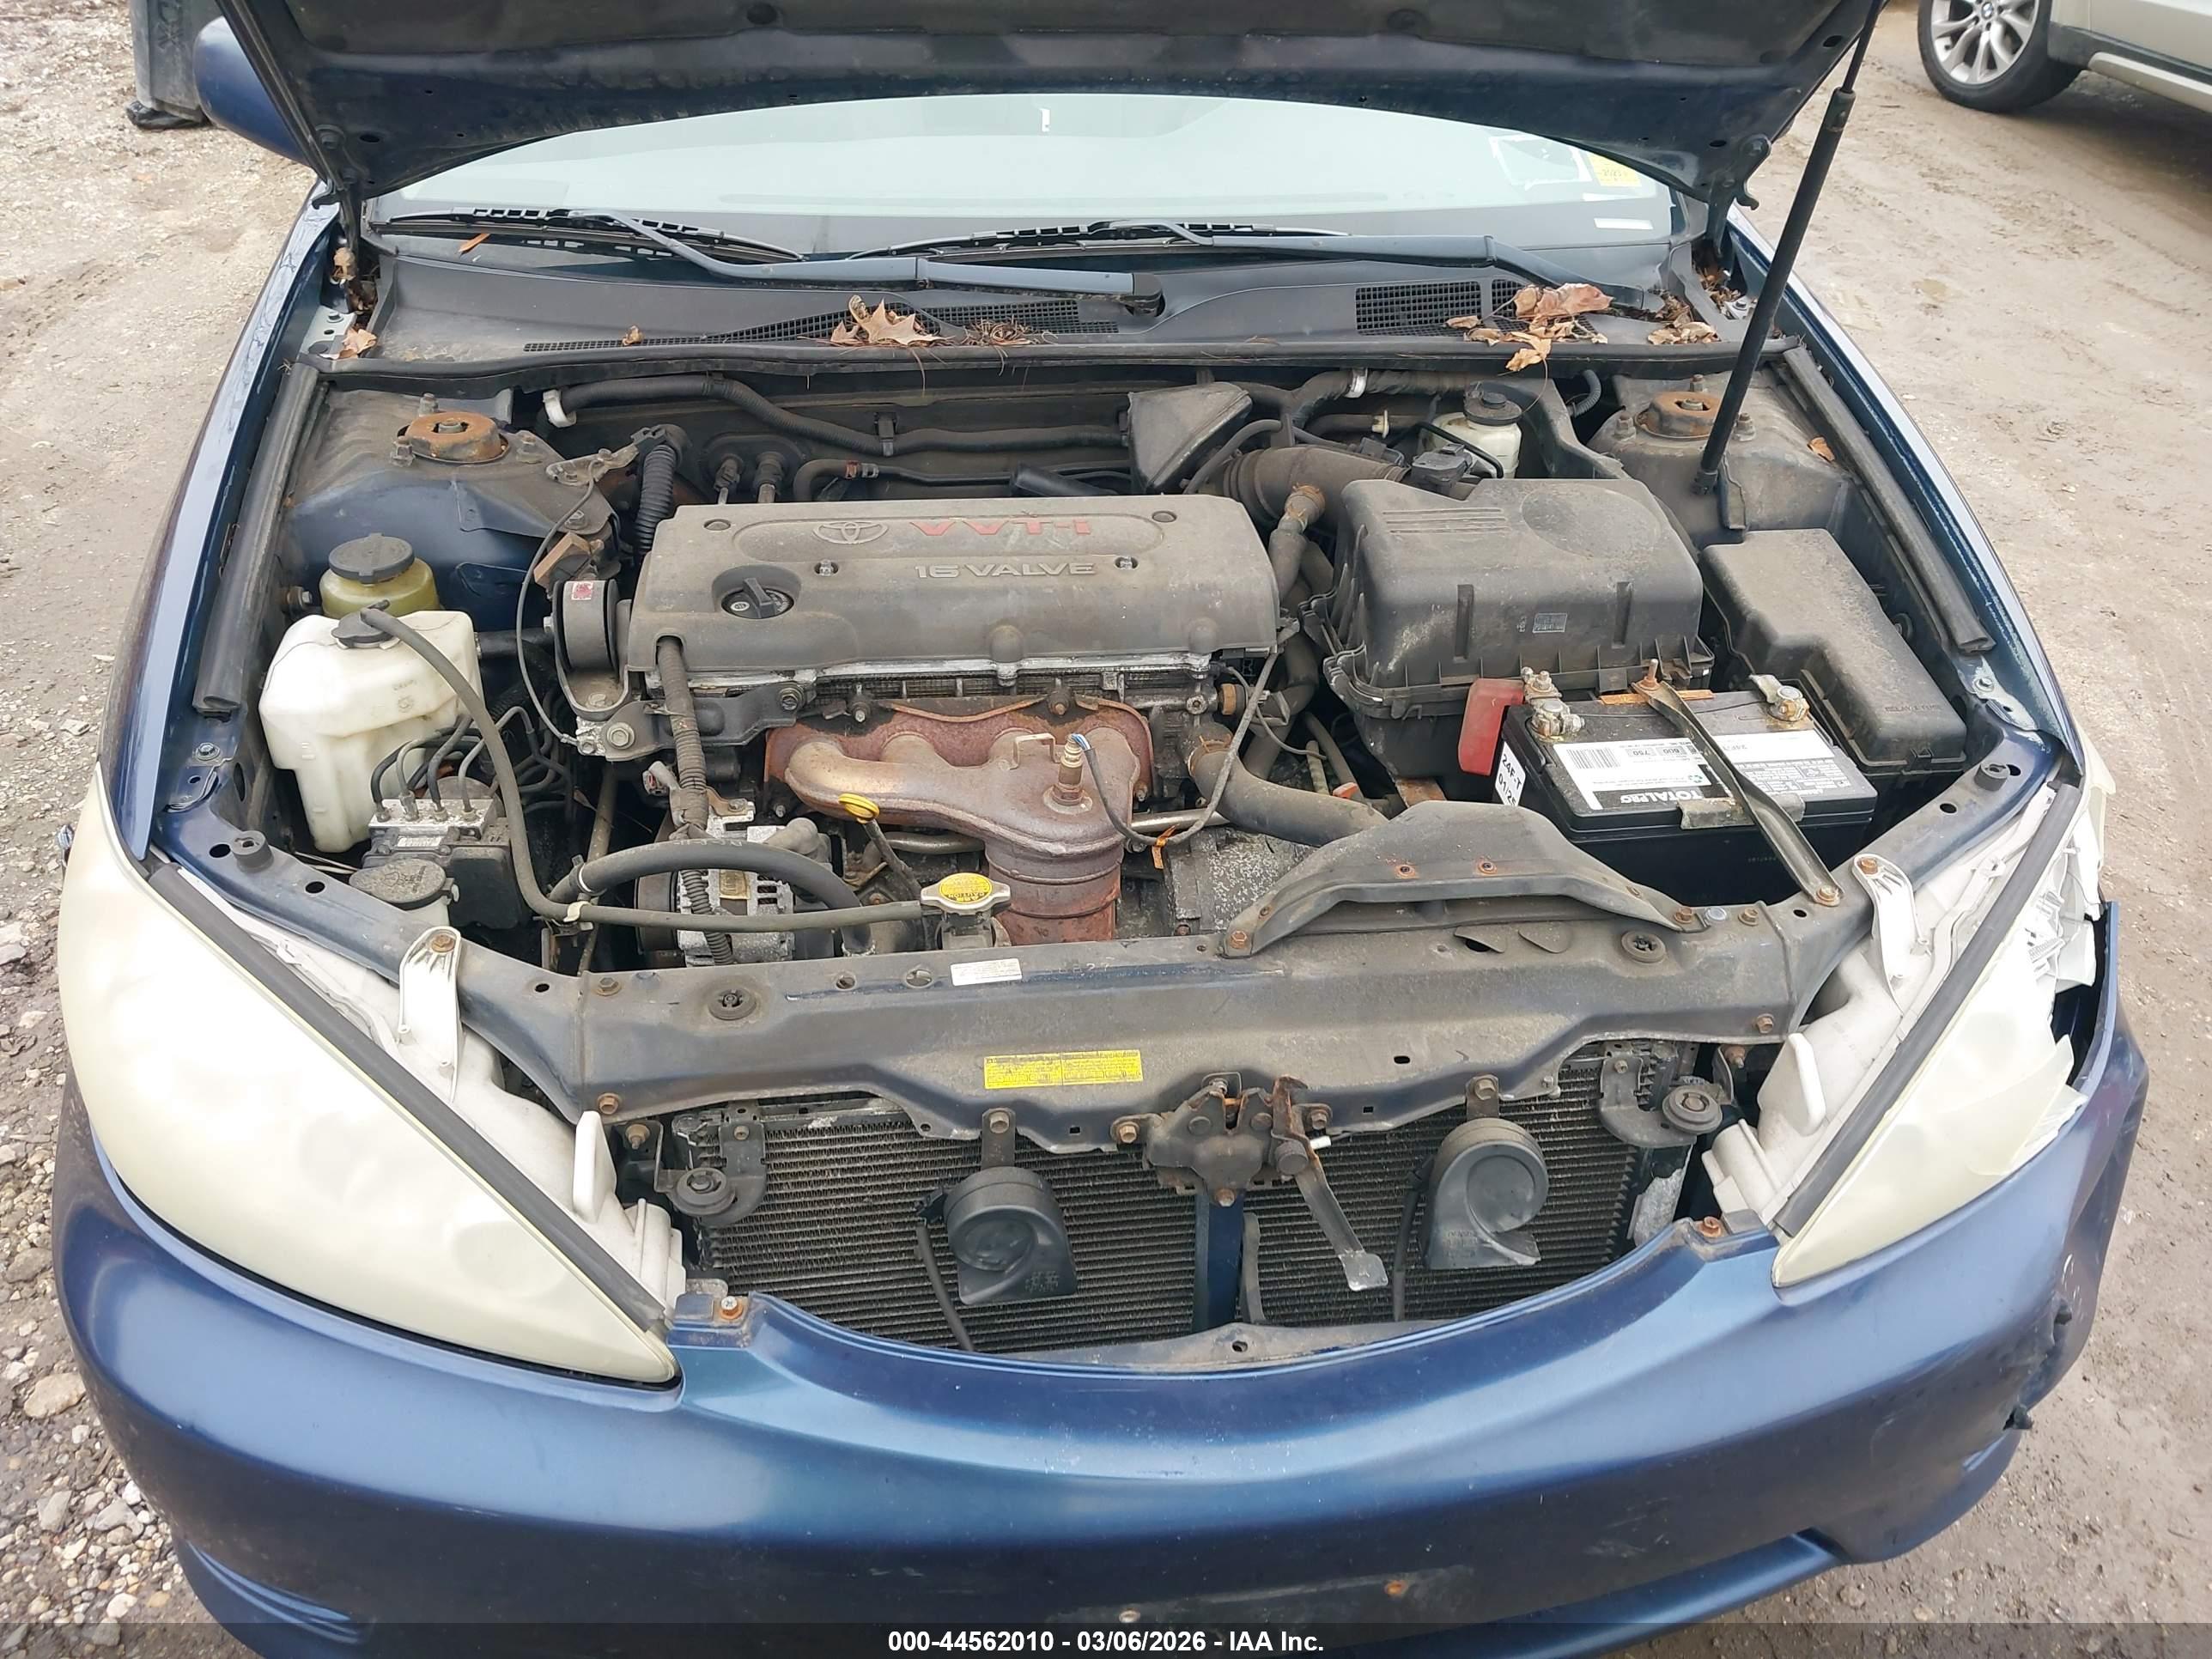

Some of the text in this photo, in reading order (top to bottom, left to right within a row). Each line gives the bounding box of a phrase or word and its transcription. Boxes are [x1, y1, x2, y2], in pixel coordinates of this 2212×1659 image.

[915, 562, 1097, 578] 16 VALVE
[1501, 754, 1522, 791] 24F-T
[1620, 788, 1703, 804] TOTALPRO
